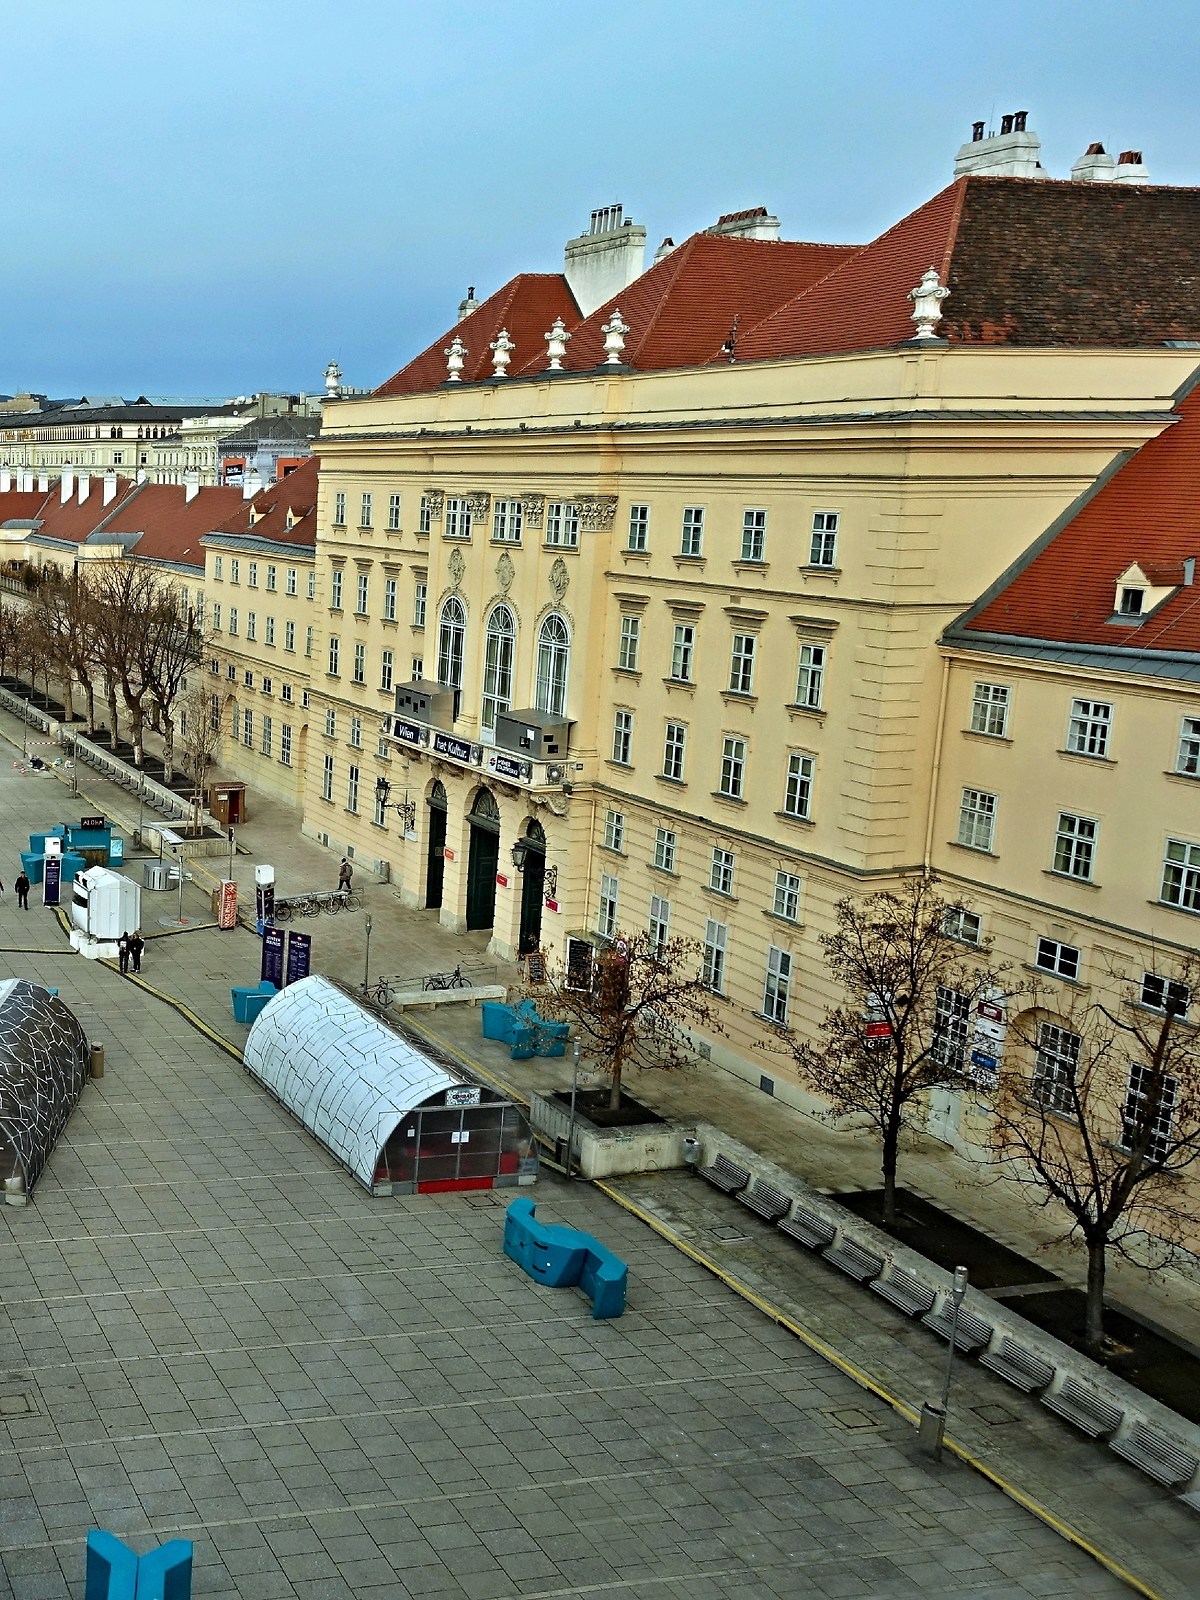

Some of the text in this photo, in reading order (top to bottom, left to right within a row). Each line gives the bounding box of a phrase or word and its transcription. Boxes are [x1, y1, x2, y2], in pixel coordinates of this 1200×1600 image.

[399, 725, 468, 759] Wien hat Kultur.
